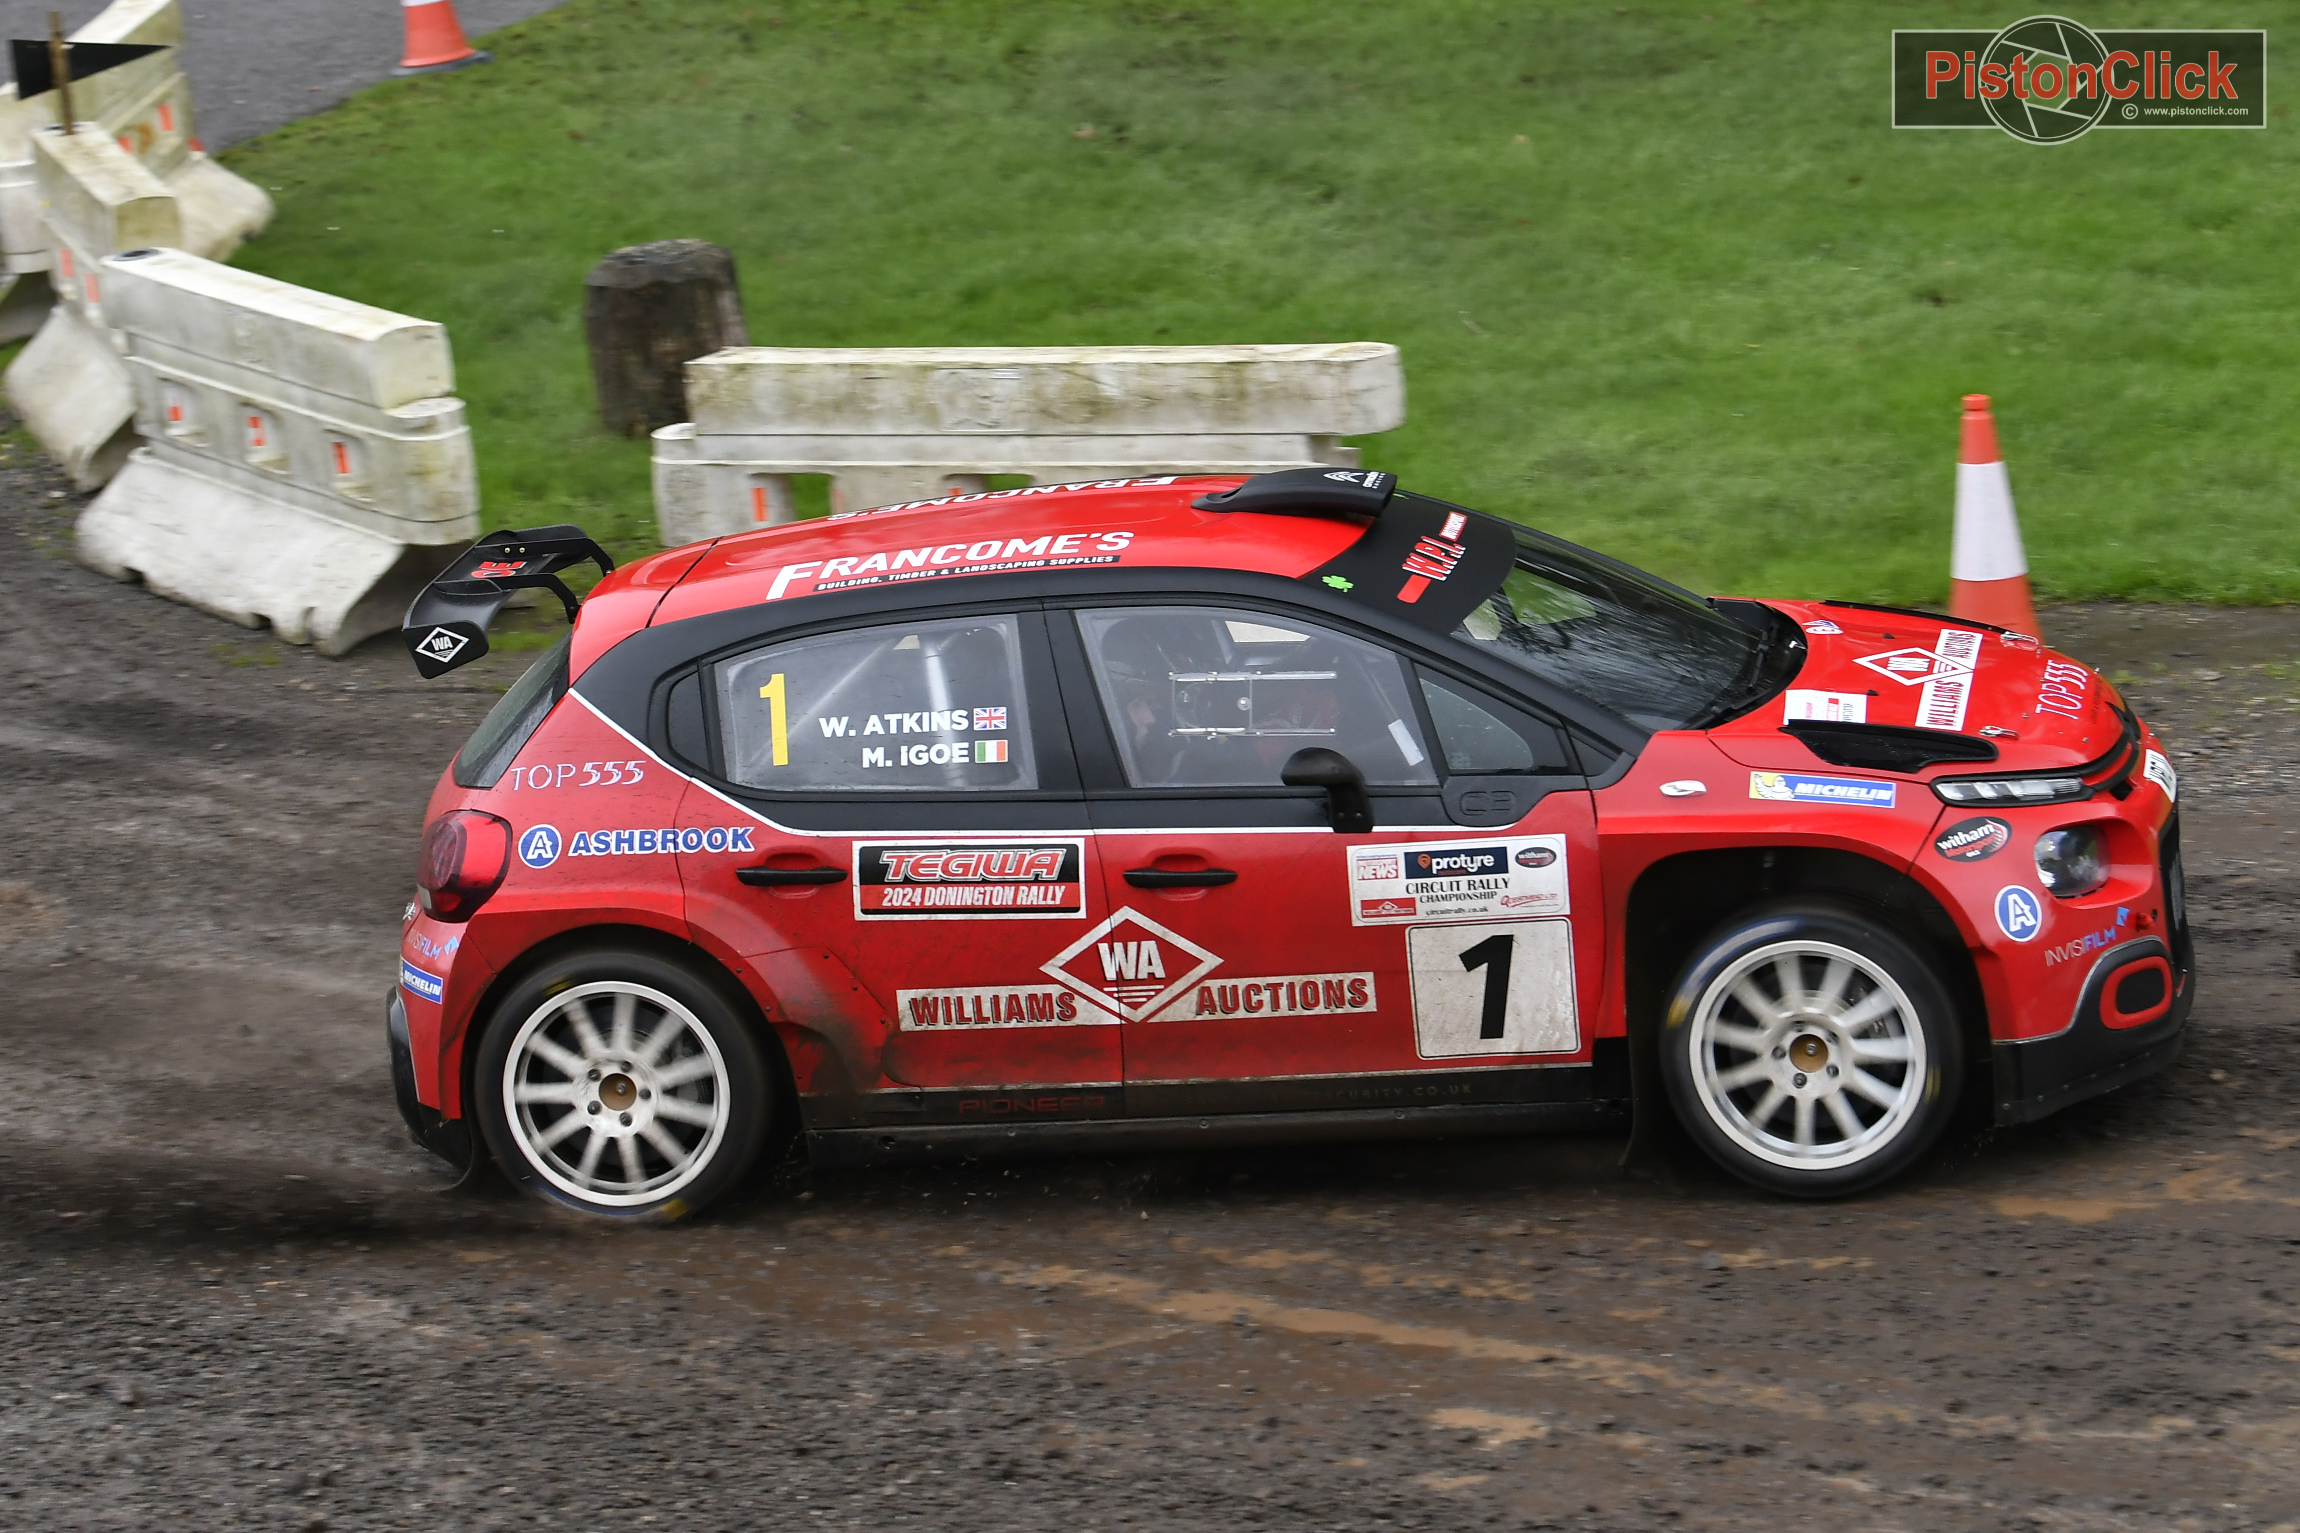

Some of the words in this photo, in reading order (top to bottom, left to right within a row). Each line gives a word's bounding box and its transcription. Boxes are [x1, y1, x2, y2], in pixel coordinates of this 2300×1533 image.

[765, 531, 1135, 600] FRANCOME'S
[888, 570, 936, 581] TIMBER
[954, 560, 1045, 574] LANDSCAPING
[1049, 555, 1114, 566] SUPPLIES
[431, 635, 453, 651] WA
[2044, 659, 2088, 690] 555
[1926, 680, 1964, 727] WILLIAMS
[2035, 682, 2083, 720] TOP
[759, 673, 789, 766] 1
[819, 716, 856, 738] W.
[863, 710, 969, 736] ATKINS
[862, 746, 893, 768] M.
[900, 742, 969, 766] IGOE
[510, 763, 576, 791] TOP
[579, 760, 646, 787] 555
[1793, 782, 1892, 801] MICHELIN
[568, 827, 755, 857] ASHBROOK
[1937, 824, 1996, 850] witham
[879, 848, 1067, 883] TEGIWA
[1358, 864, 1398, 880] NEWS
[1431, 854, 1495, 874] protyre
[882, 887, 922, 907] 2024
[924, 886, 1015, 906] DONINGTON
[1016, 885, 1066, 905] RALLY
[1406, 880, 1462, 894] CIRCUIT
[1467, 877, 1510, 891] RALLY
[1420, 891, 1497, 903] CHAMPIONSHIP
[1097, 940, 1166, 981] WA
[2044, 925, 2117, 967] INVISIFILM
[404, 969, 441, 996] MICHELIN
[1458, 934, 1514, 1040] 1
[909, 990, 1078, 1027] WILLIAMS
[1196, 978, 1370, 1017] AUCTIONS
